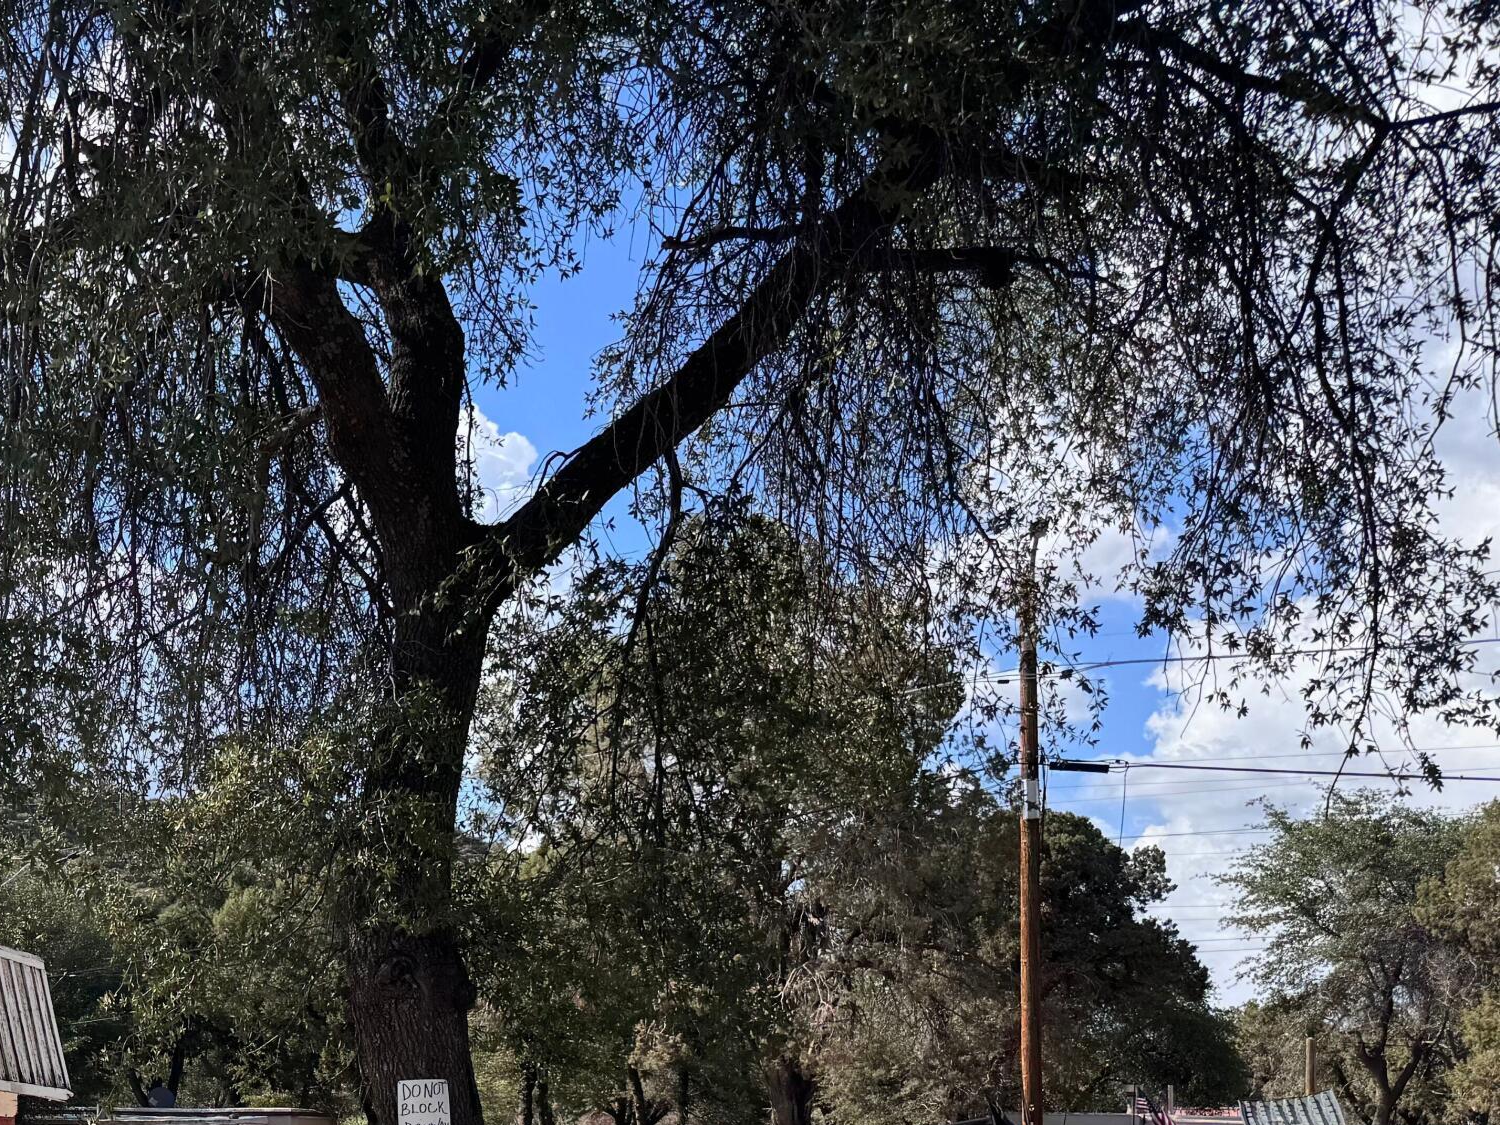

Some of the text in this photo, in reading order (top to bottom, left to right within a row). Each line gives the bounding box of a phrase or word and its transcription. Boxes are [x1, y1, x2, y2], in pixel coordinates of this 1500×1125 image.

[402, 1081, 446, 1100] DO NOT
[401, 1101, 448, 1116] BLOCK
